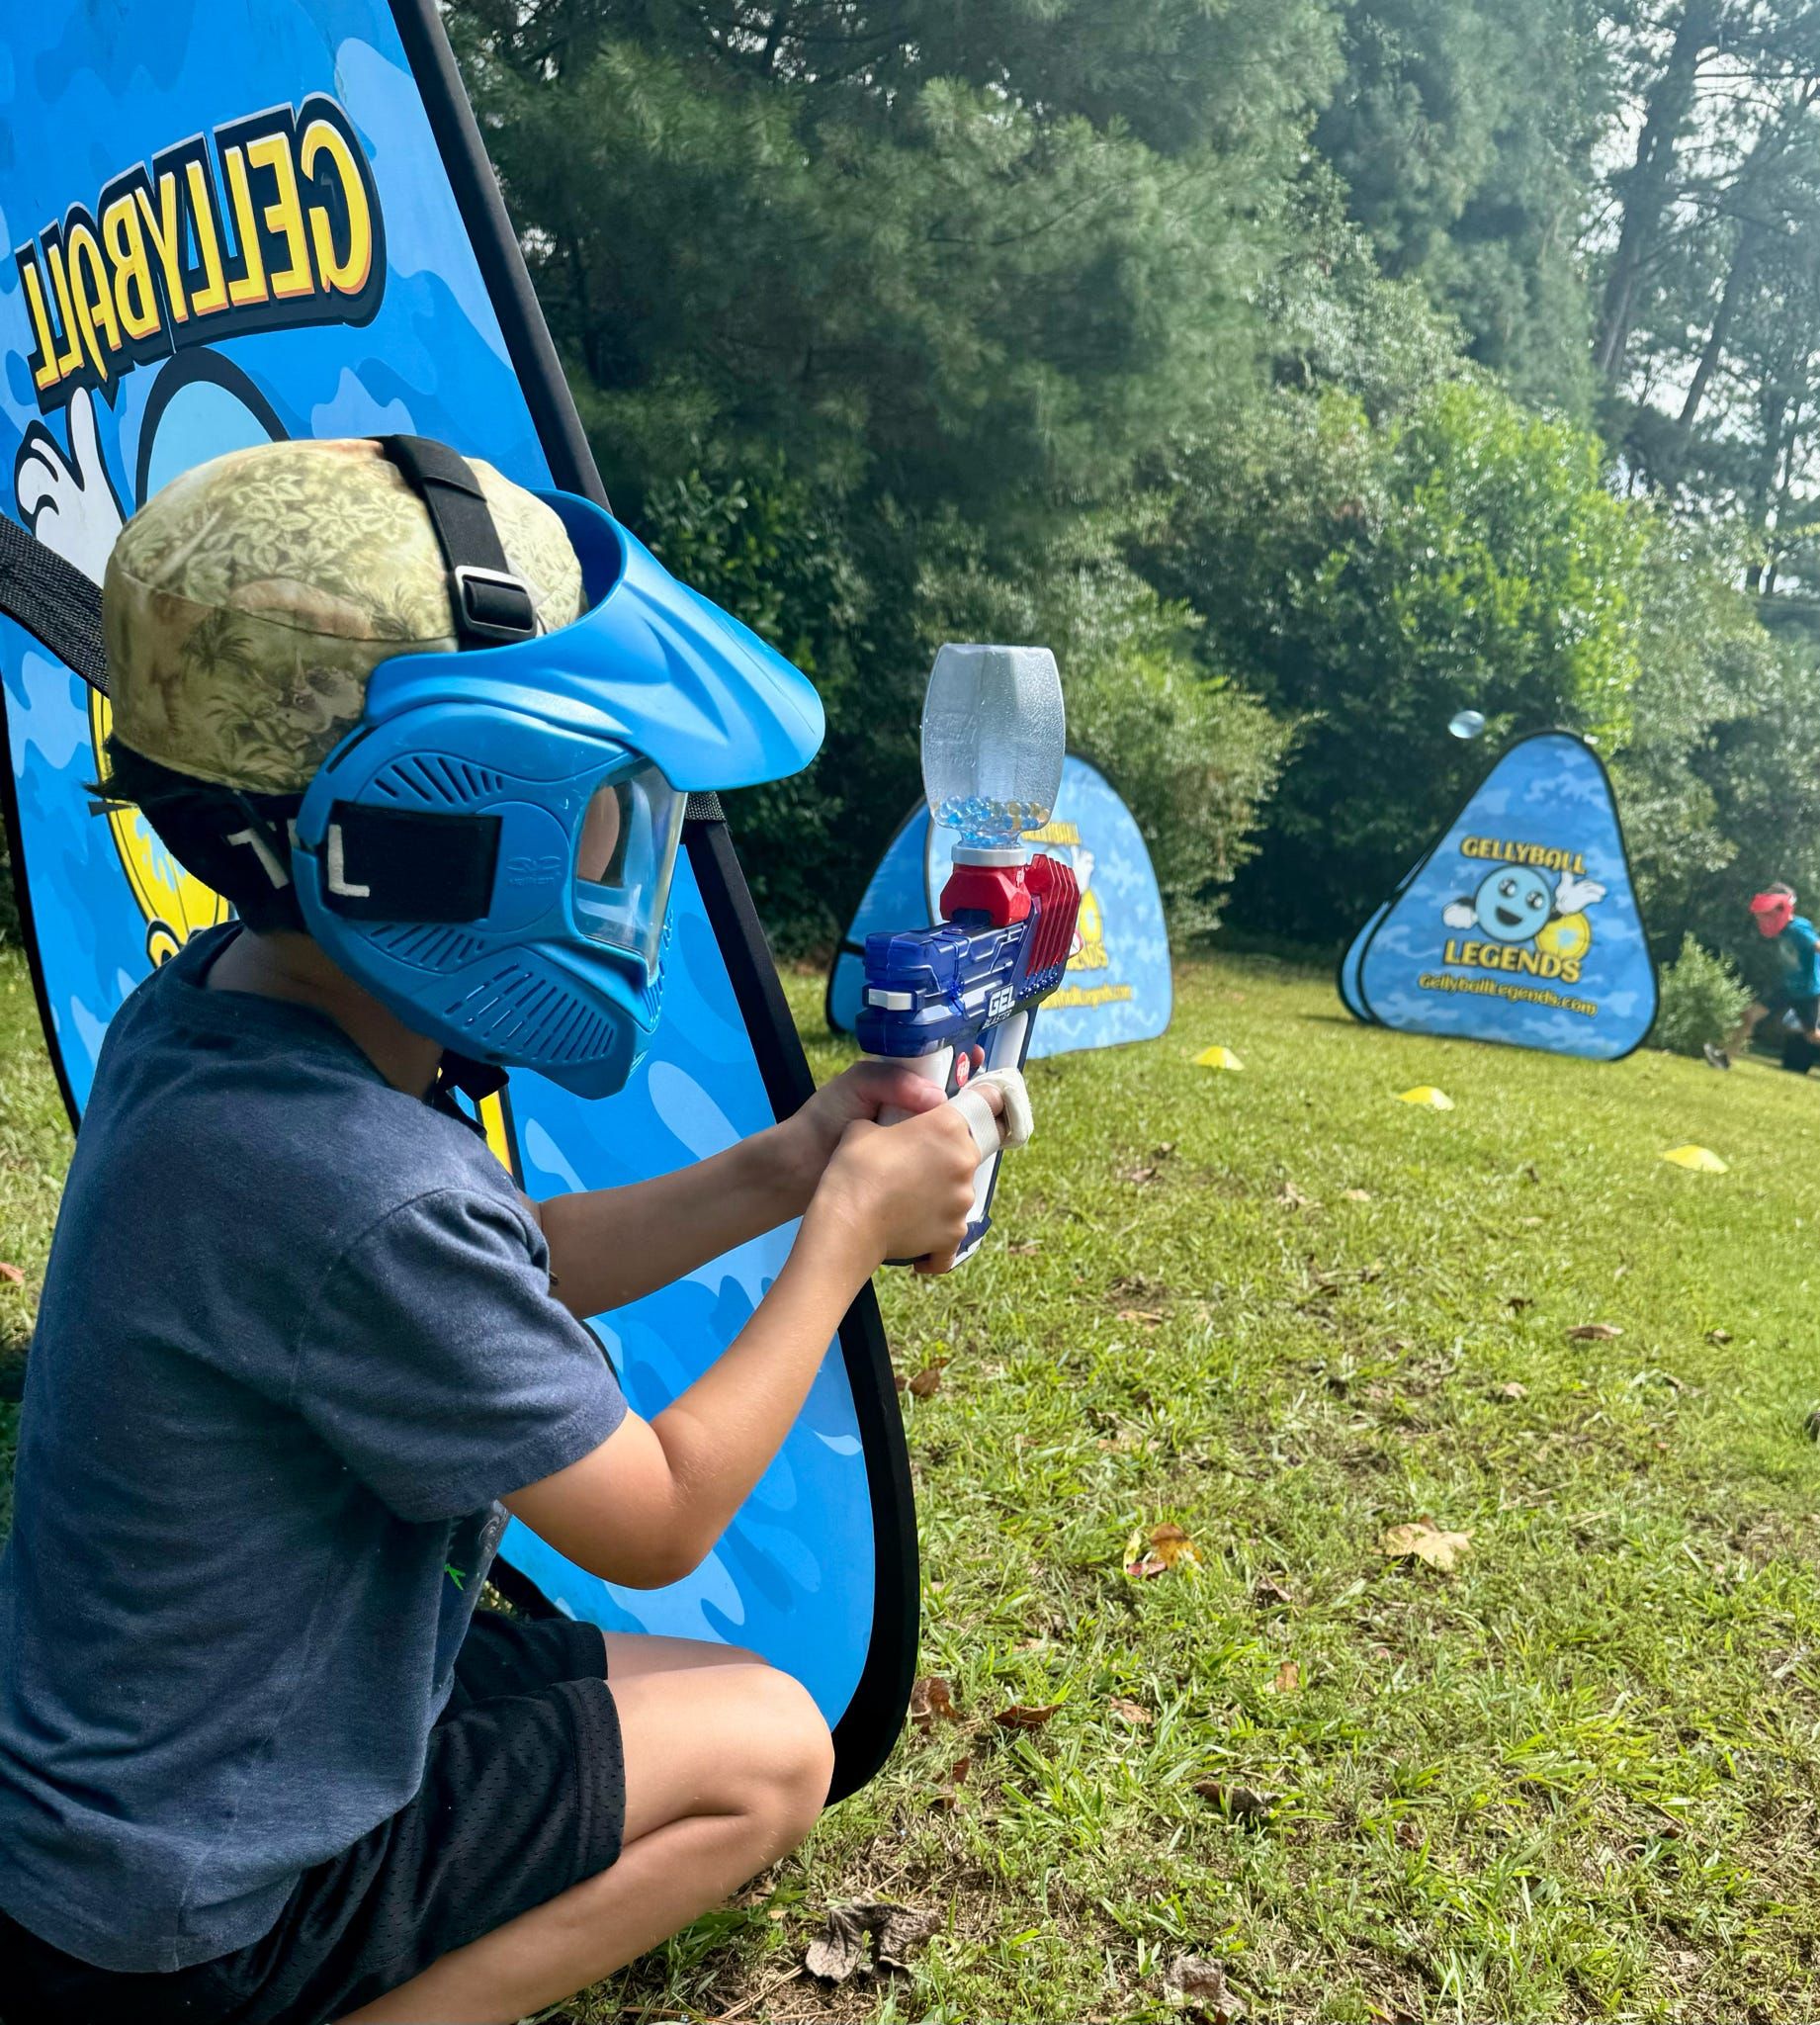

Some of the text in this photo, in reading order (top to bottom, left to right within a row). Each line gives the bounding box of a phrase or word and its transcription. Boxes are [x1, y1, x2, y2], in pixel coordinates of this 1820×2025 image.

[1461, 836, 1587, 876] GELLYBALL
[1444, 938, 1582, 983] LEGENDS
[989, 985, 1015, 1017] GEL
